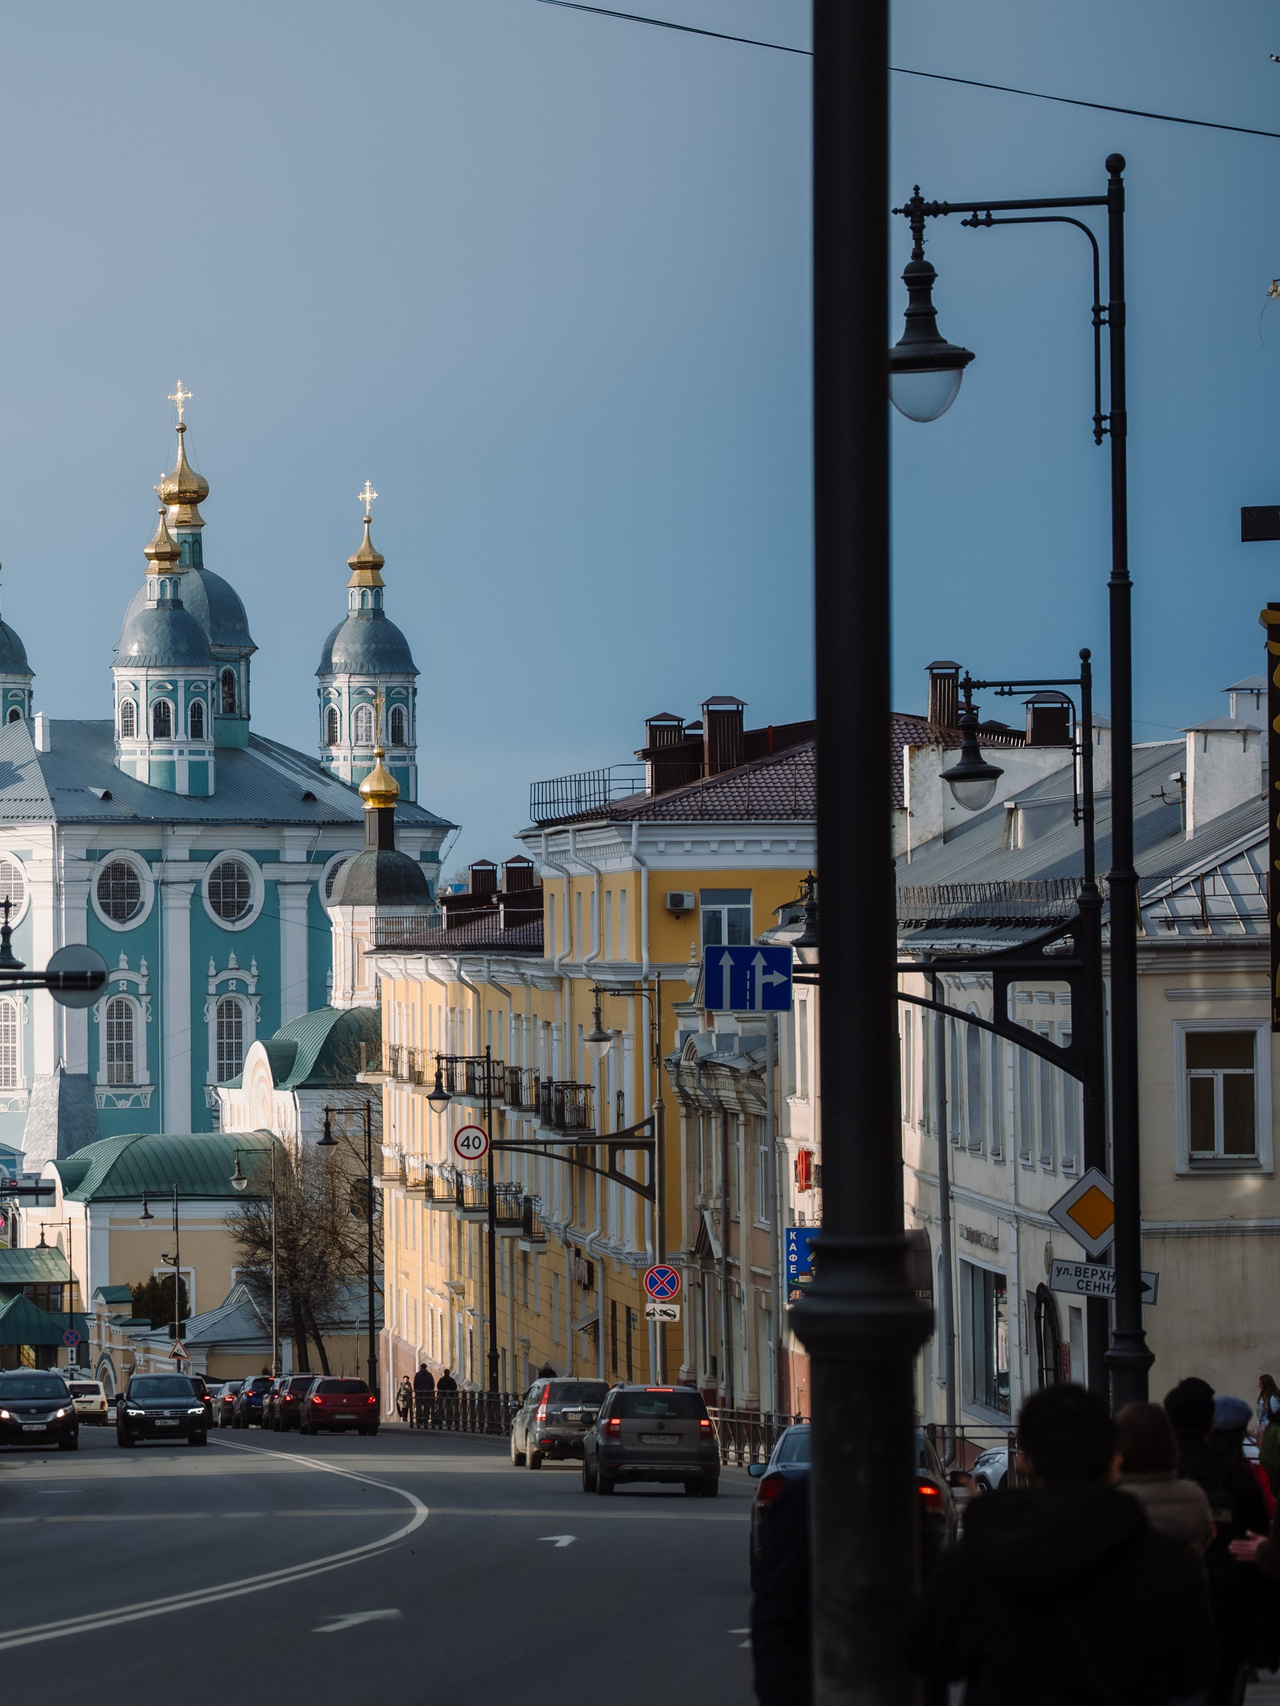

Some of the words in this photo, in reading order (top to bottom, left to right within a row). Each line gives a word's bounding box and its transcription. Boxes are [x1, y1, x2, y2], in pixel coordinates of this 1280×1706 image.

[461, 1135, 482, 1150] 40
[788, 1231, 798, 1274] КАФЕ
[1056, 1266, 1072, 1277] ул.
[1074, 1266, 1116, 1282] ВЕРХН
